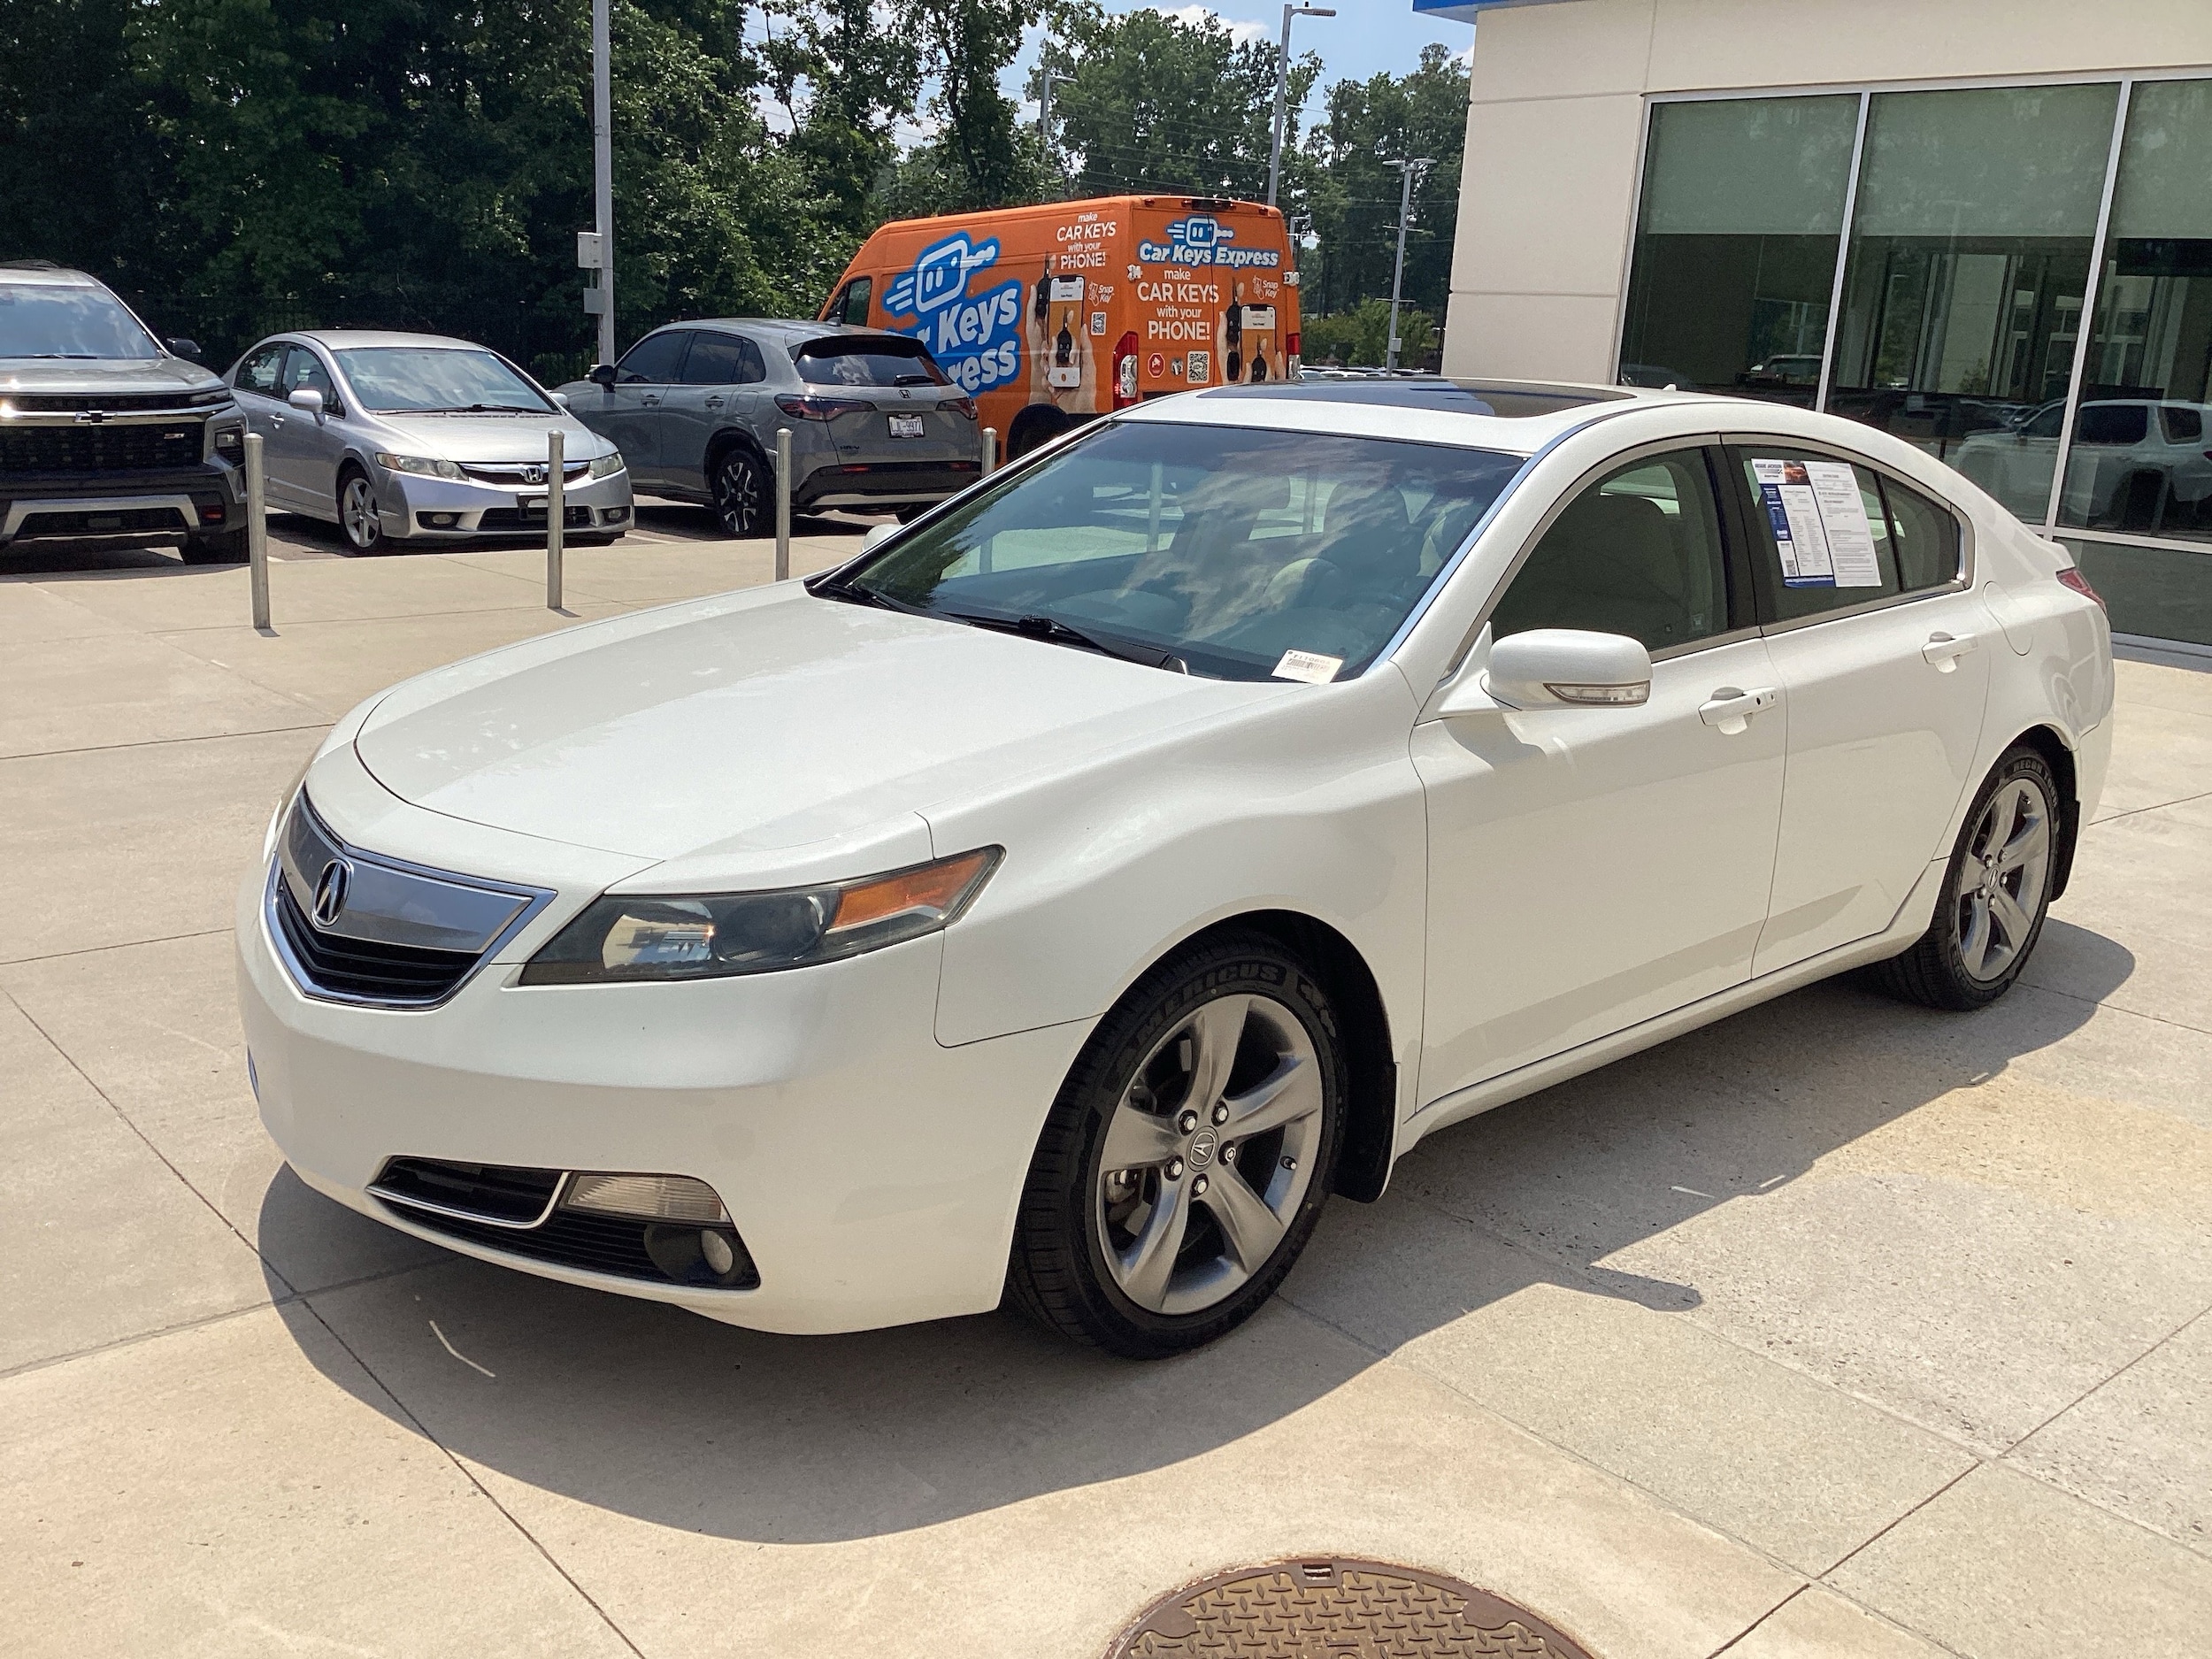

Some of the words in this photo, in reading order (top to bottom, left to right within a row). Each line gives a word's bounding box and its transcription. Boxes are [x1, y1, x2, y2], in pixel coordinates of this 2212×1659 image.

[1078, 212, 1097, 222] make
[1056, 225, 1081, 242] CAR
[1084, 221, 1117, 239] KEYS
[1068, 242, 1084, 253] with
[1084, 242, 1101, 252] your
[1139, 242, 1170, 261] Car
[1171, 244, 1211, 266] Keys
[1213, 246, 1279, 267] Express
[1060, 251, 1106, 269] PHONE!
[1164, 267, 1191, 280] make
[1098, 284, 1114, 294] Snap
[1137, 281, 1173, 302] CAR
[1177, 283, 1219, 303] KEYS
[1263, 280, 1279, 289] Snap
[1099, 293, 1112, 304] Key
[1156, 304, 1178, 318] with
[1179, 308, 1202, 319] your
[938, 288, 1018, 354] Keys
[1148, 320, 1210, 341] PHONE!
[948, 340, 1016, 391] ress
